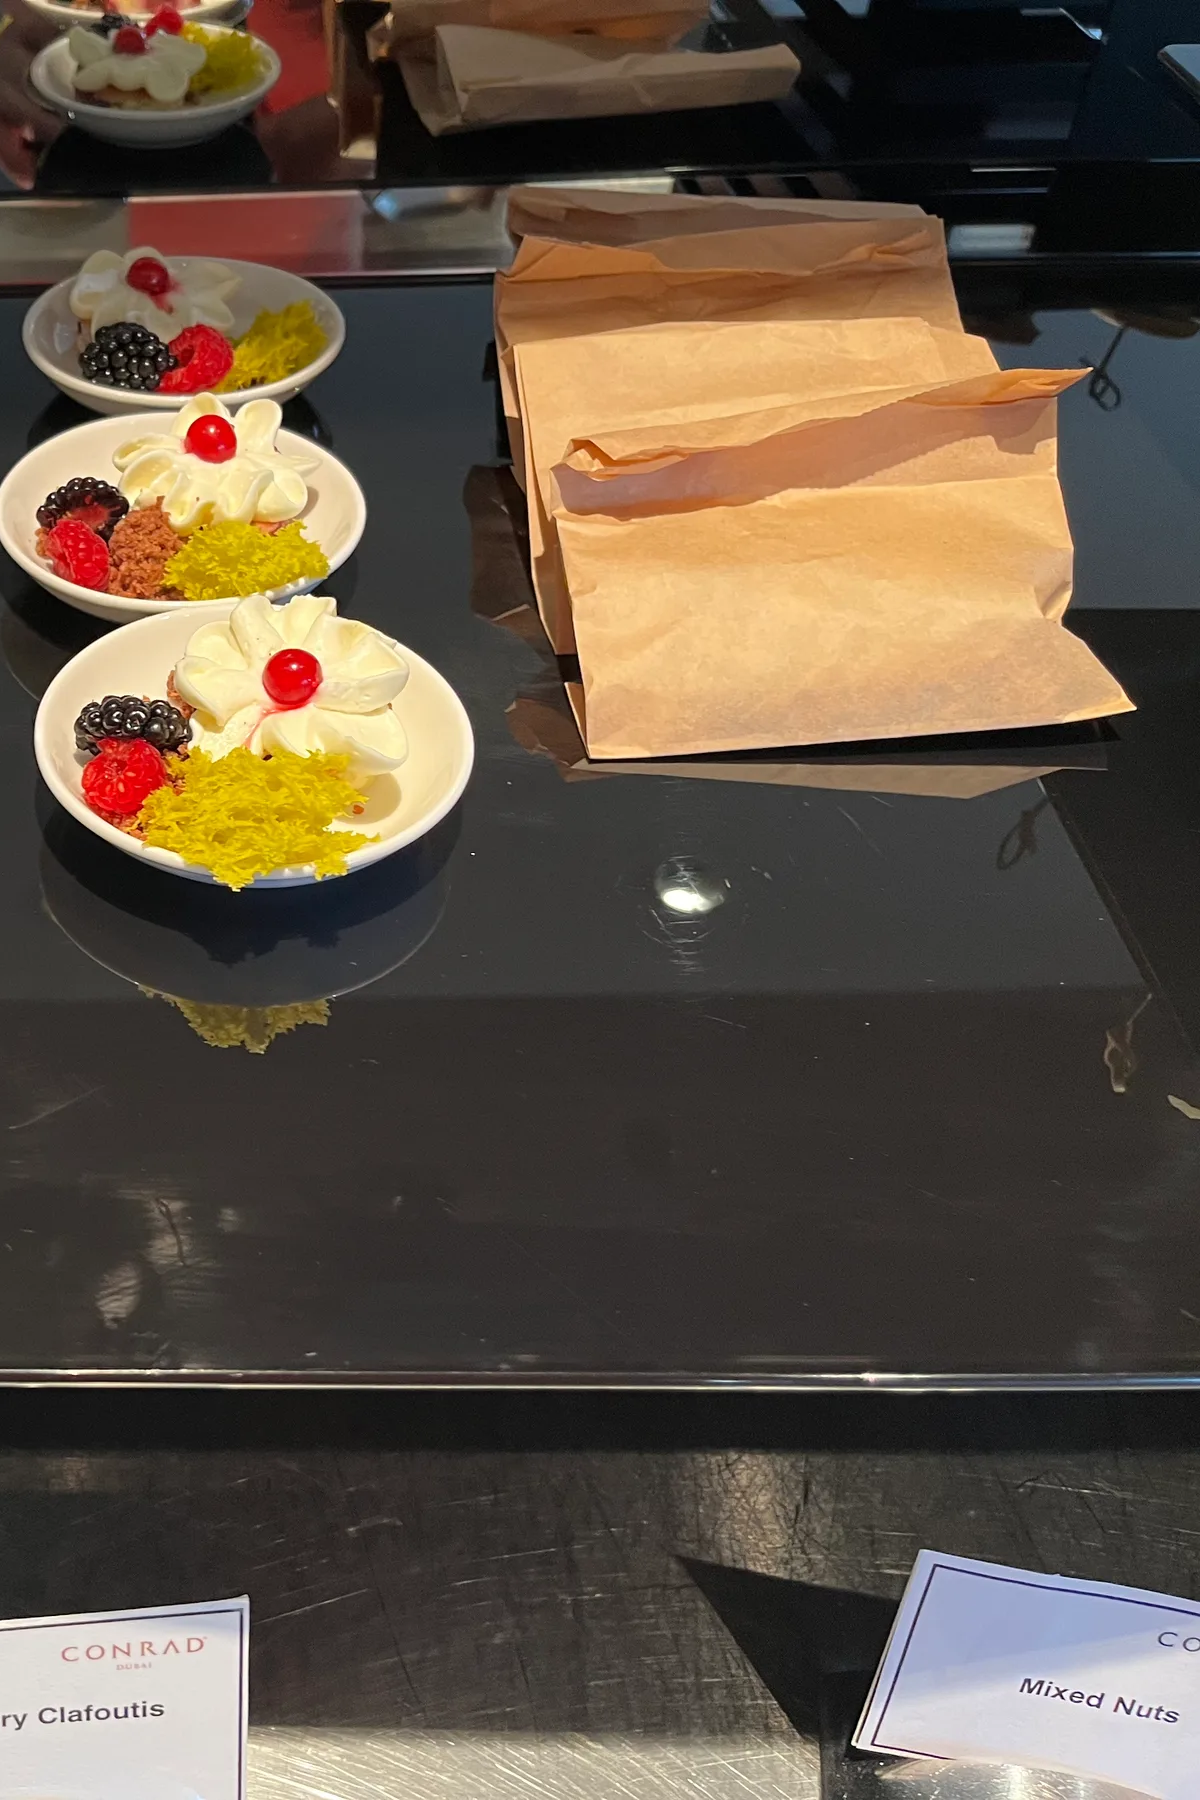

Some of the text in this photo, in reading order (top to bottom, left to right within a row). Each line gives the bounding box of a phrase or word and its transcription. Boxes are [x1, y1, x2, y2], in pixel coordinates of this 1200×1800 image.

[61, 1637, 204, 1662] CONRAD
[38, 1700, 165, 1725] Clafoutis
[1019, 1677, 1181, 1724] Mixed Nuts
